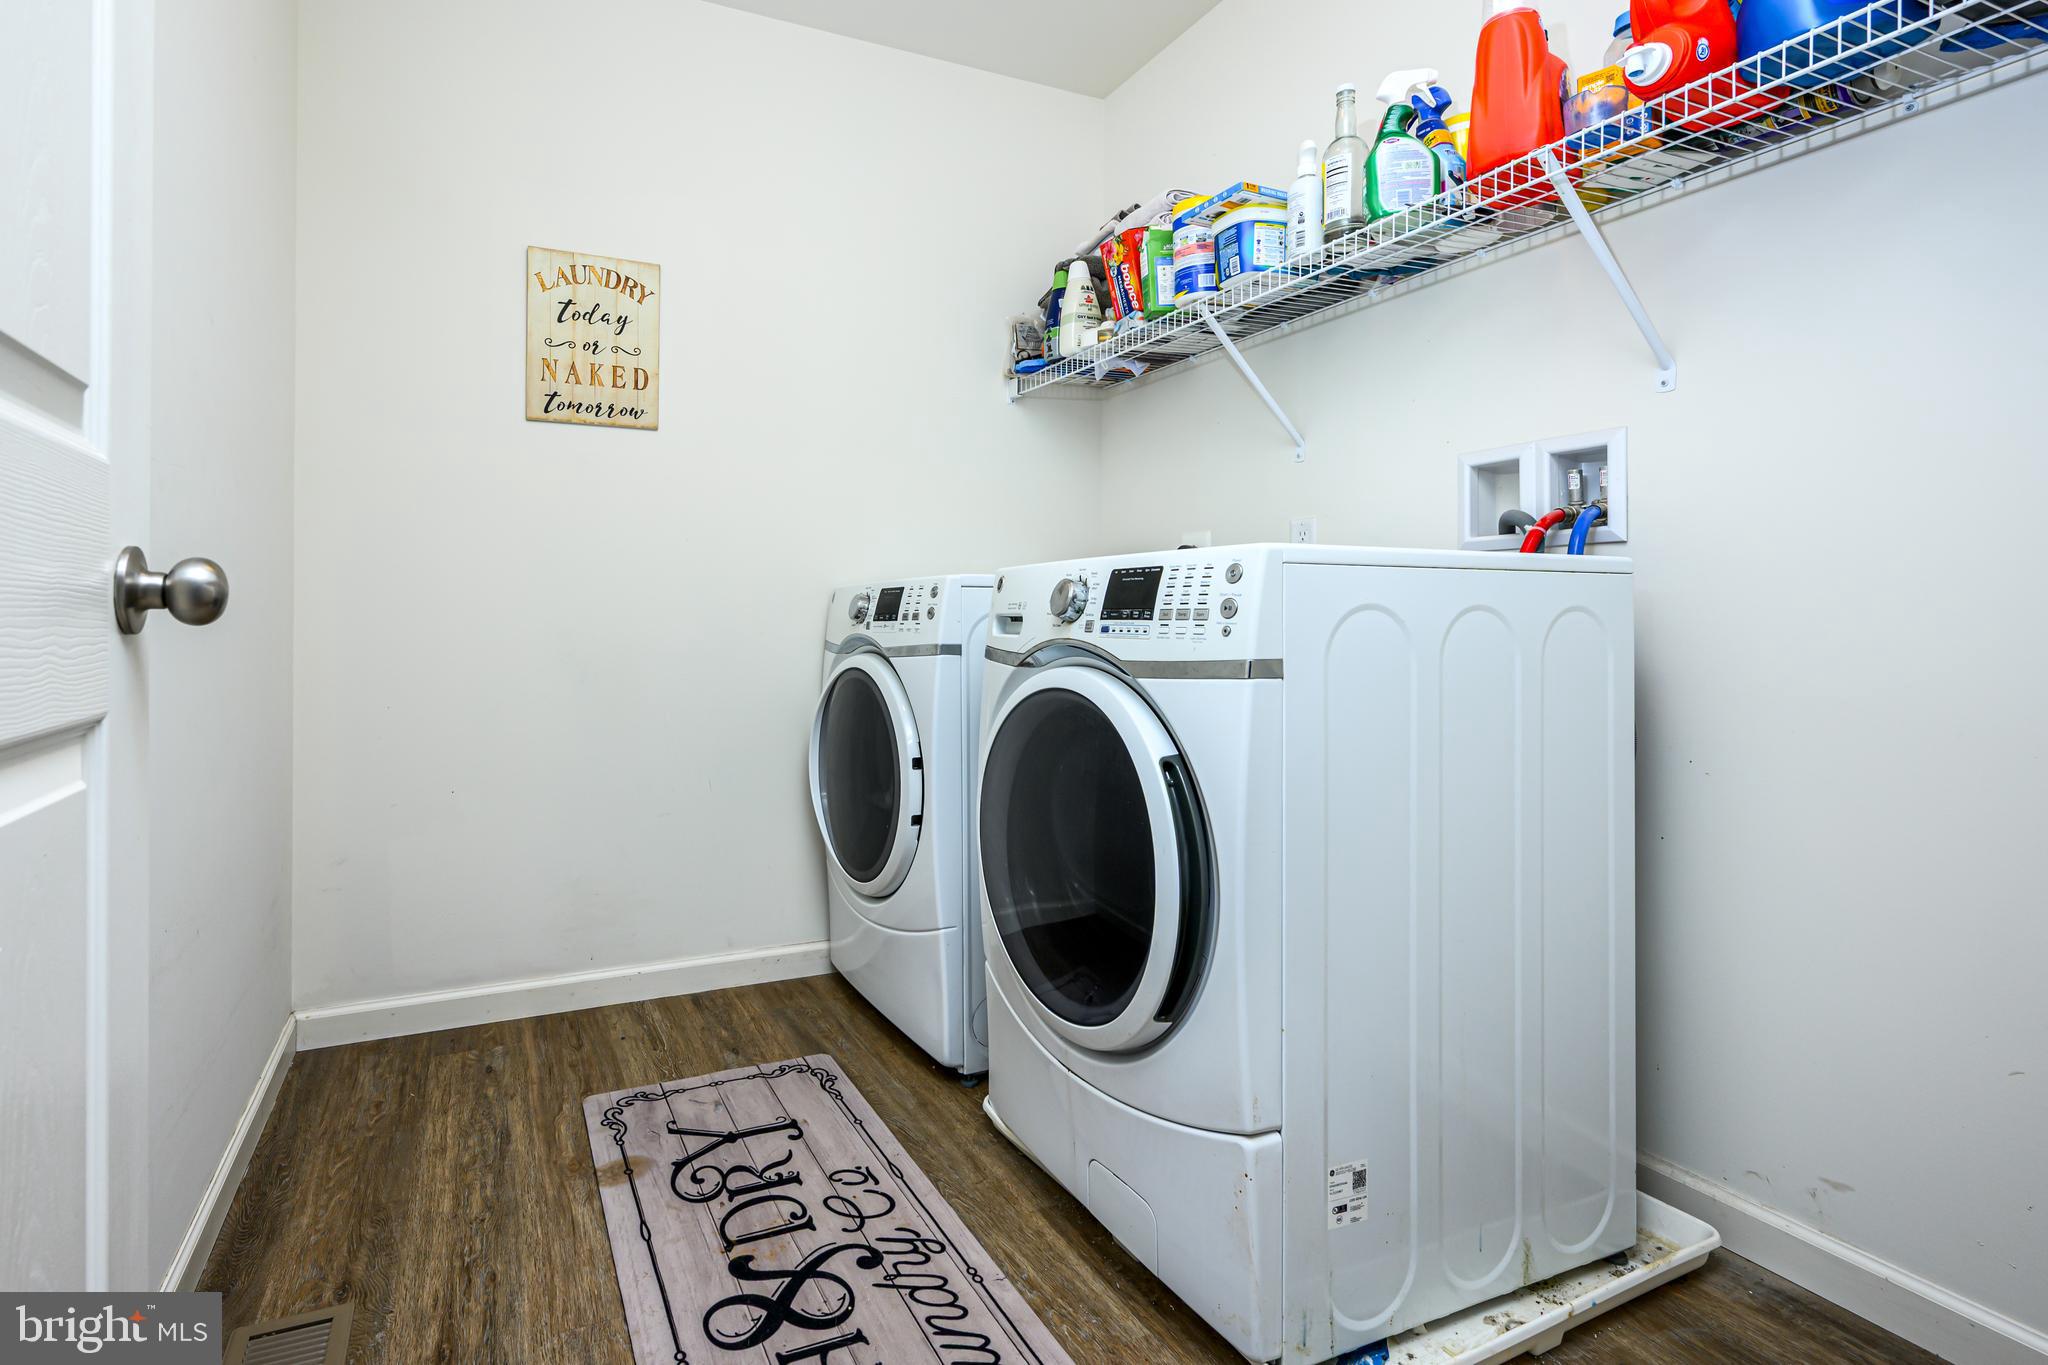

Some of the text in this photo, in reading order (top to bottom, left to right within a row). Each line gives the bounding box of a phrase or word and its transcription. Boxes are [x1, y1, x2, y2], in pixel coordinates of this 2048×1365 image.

[534, 264, 655, 306] LAUNDRY
[1120, 263, 1139, 309] bounce
[556, 298, 633, 336] today
[582, 340, 607, 356] or
[540, 357, 650, 391] NAKED
[543, 391, 648, 420] tomorrow
[666, 1116, 816, 1254] DRY
[871, 1227, 1002, 1365] undry
